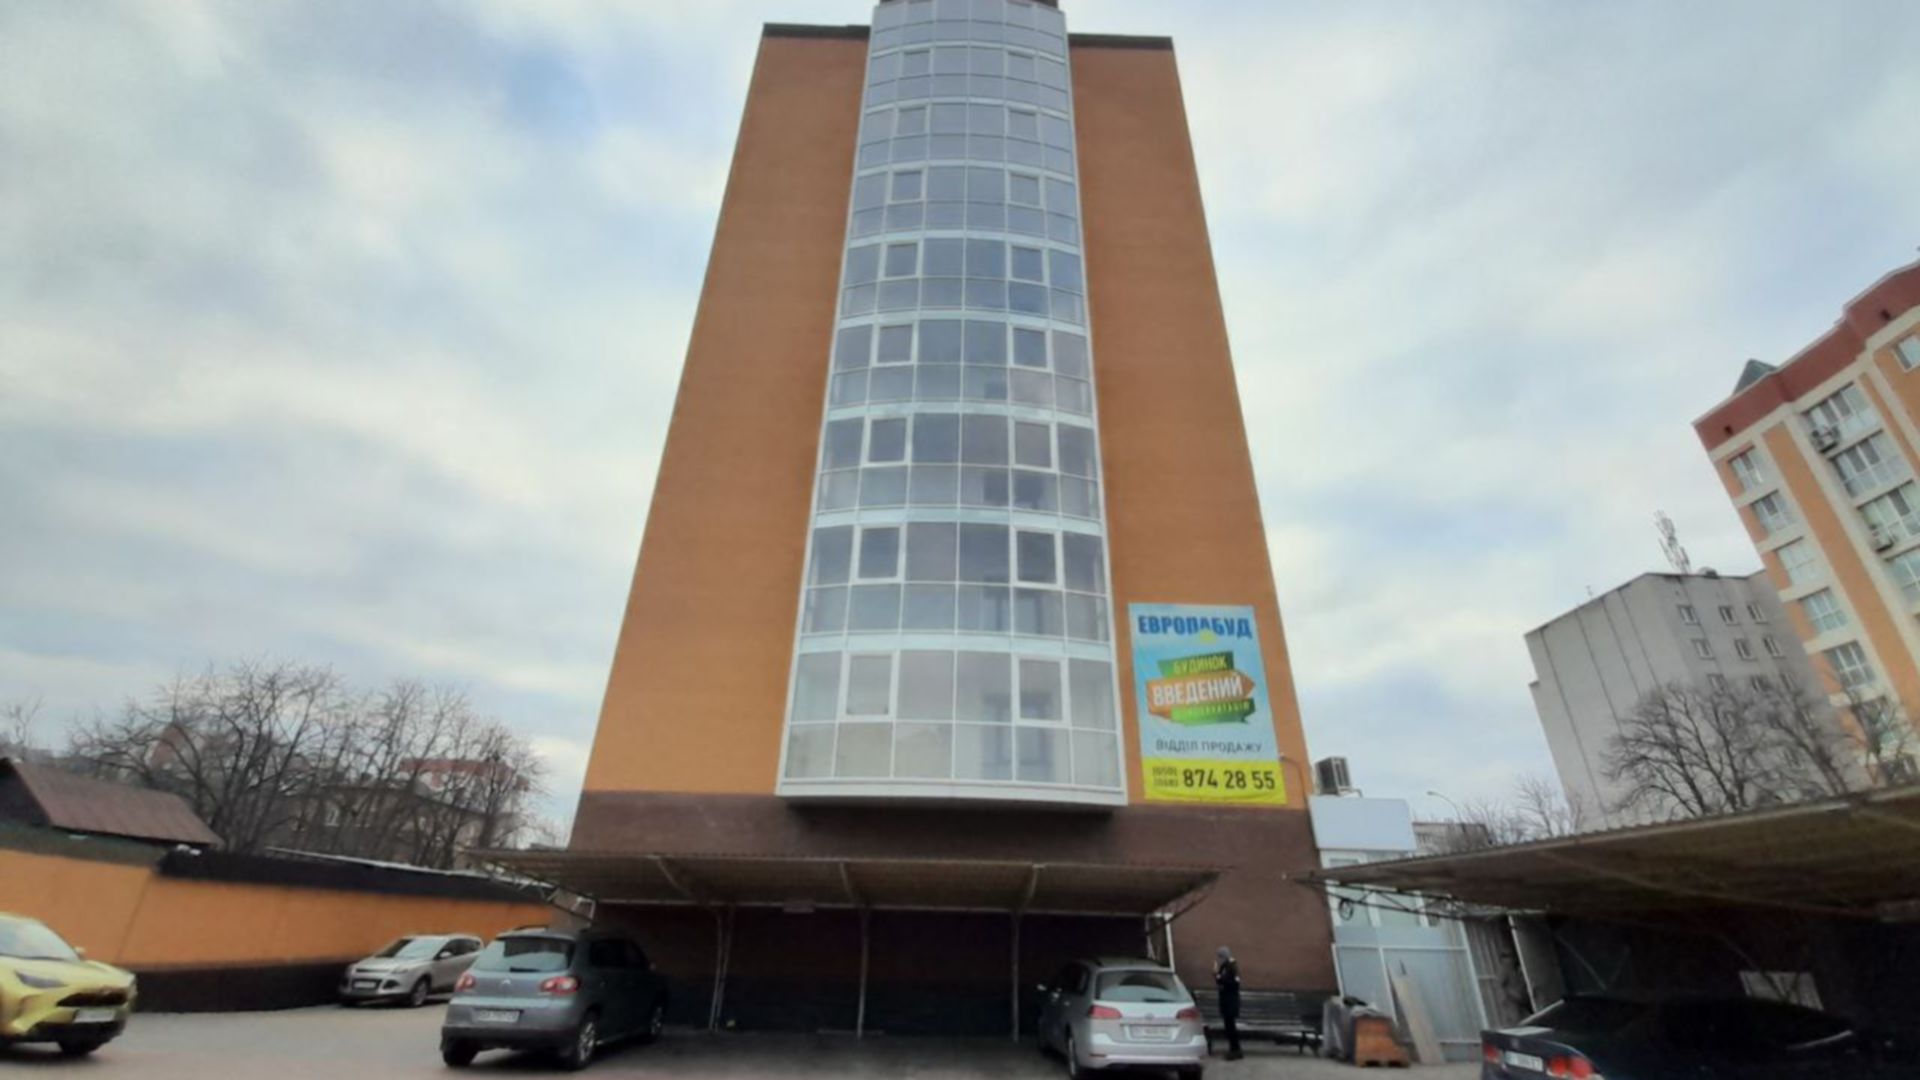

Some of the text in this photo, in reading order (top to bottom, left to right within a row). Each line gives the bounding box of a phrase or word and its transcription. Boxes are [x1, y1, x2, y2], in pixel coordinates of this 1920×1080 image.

[1138, 616, 1252, 638] ЕВРОПАБУД
[1174, 656, 1227, 674] БУДИНОК
[1156, 739, 1262, 753] ВІДДІЛ ПРОДАЖУ
[1183, 768, 1218, 788] 874
[1224, 770, 1247, 789] 28
[1251, 771, 1275, 790] 55
